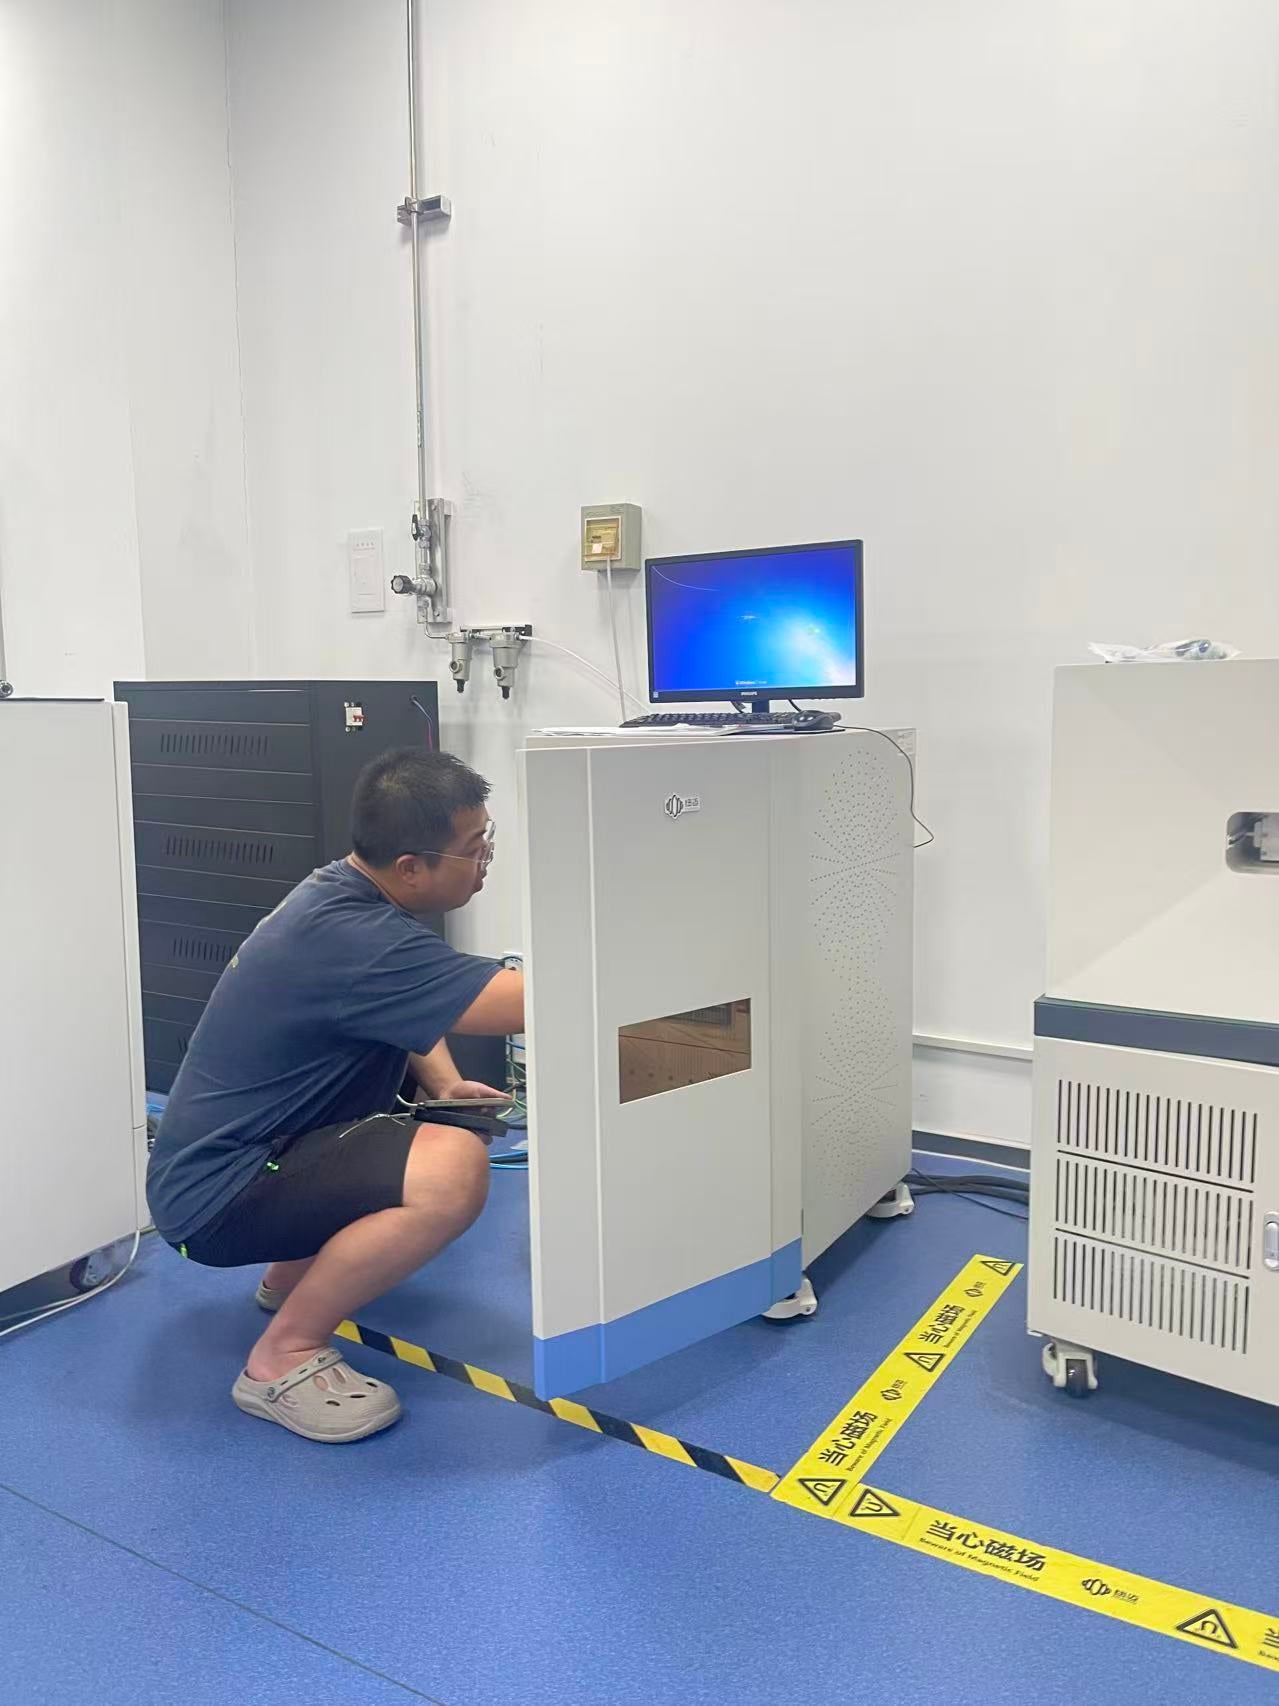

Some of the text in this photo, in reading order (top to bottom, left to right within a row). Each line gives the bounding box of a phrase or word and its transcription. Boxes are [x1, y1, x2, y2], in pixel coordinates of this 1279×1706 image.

[918, 1304, 965, 1344] 当心磁场
[818, 1410, 878, 1466] 当心磁场
[846, 1454, 864, 1471] Beware
[864, 1430, 885, 1449] Magnetic
[879, 1417, 893, 1429] Field
[919, 1537, 1041, 1582] Beware of Magnetic Field
[926, 1519, 1047, 1571] 当心磁场
